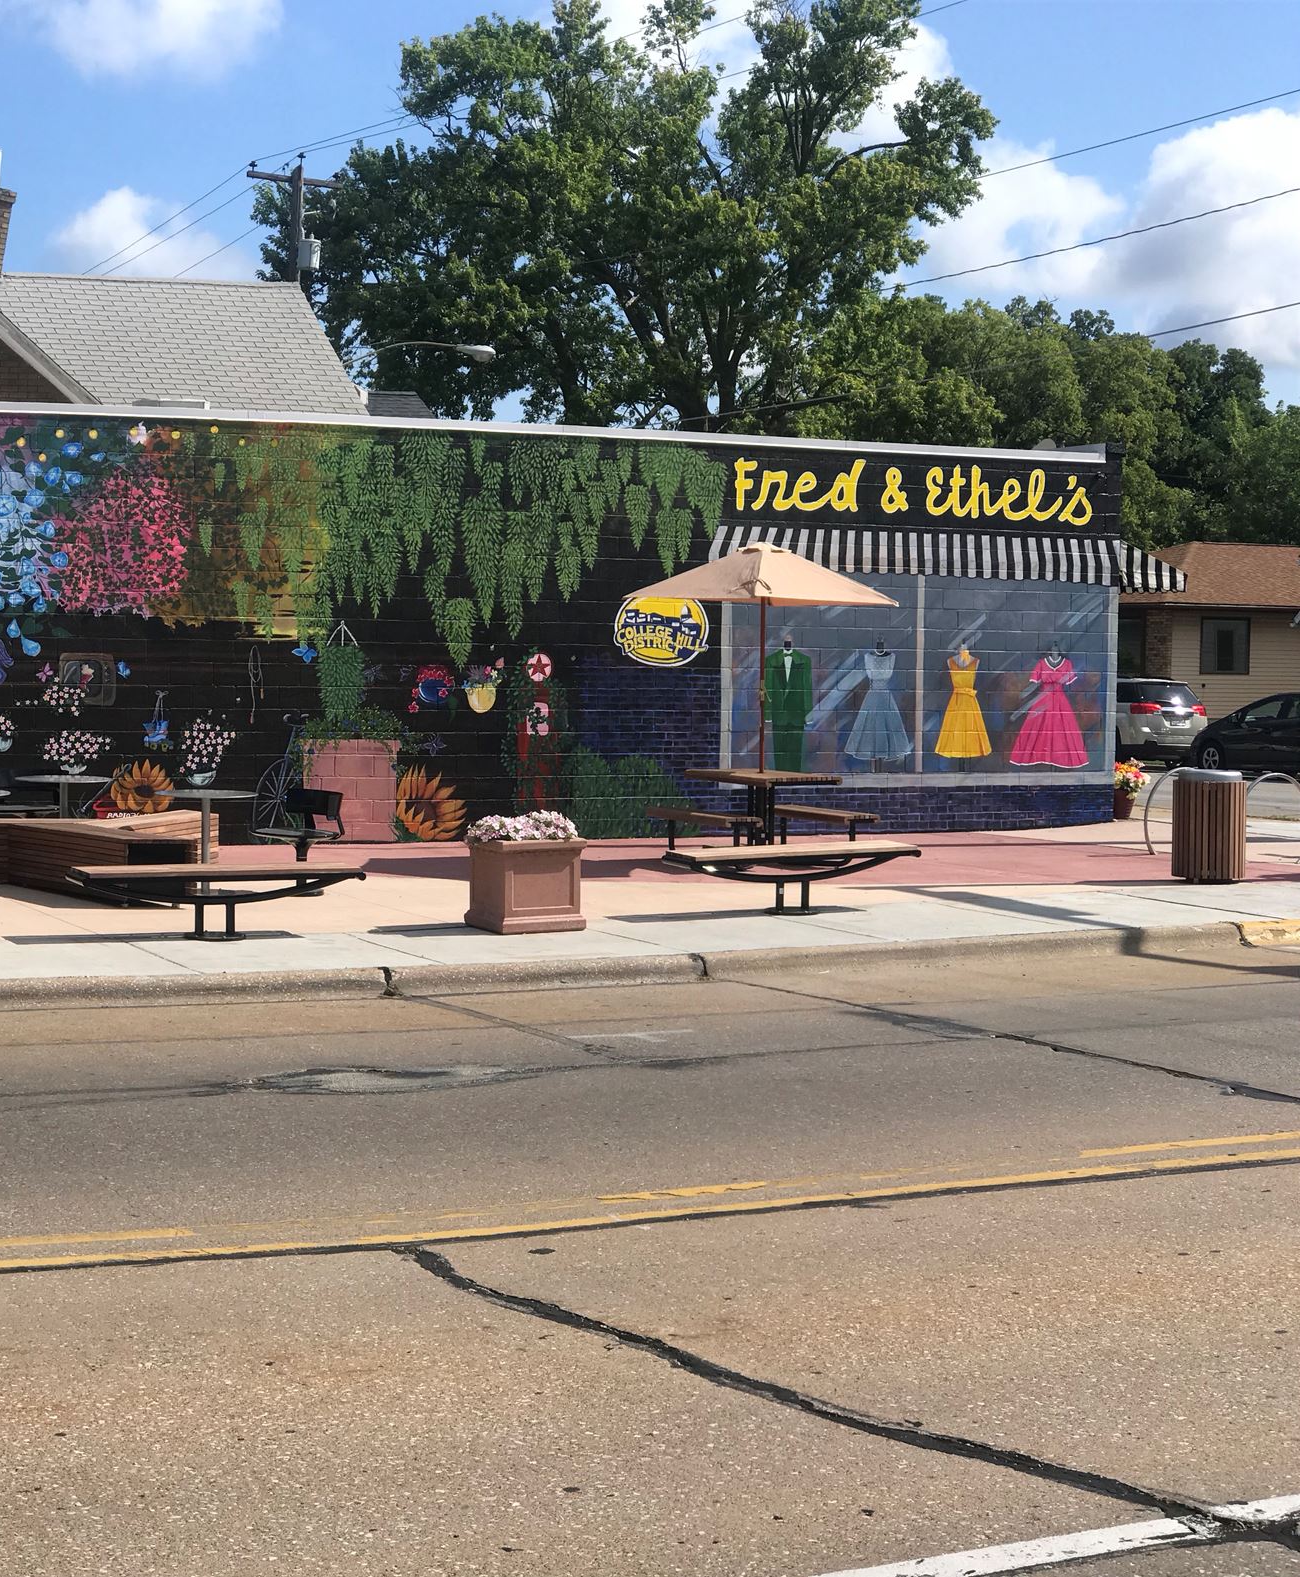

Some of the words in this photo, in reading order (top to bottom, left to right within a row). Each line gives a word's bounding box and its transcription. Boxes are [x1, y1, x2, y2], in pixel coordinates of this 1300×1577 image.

[734, 457, 867, 513] Fred
[881, 466, 909, 514] &
[925, 463, 1093, 526] Ethel's
[616, 625, 674, 644] COLLEGE
[676, 631, 708, 652] HILL
[624, 636, 683, 657] DISTRICT
